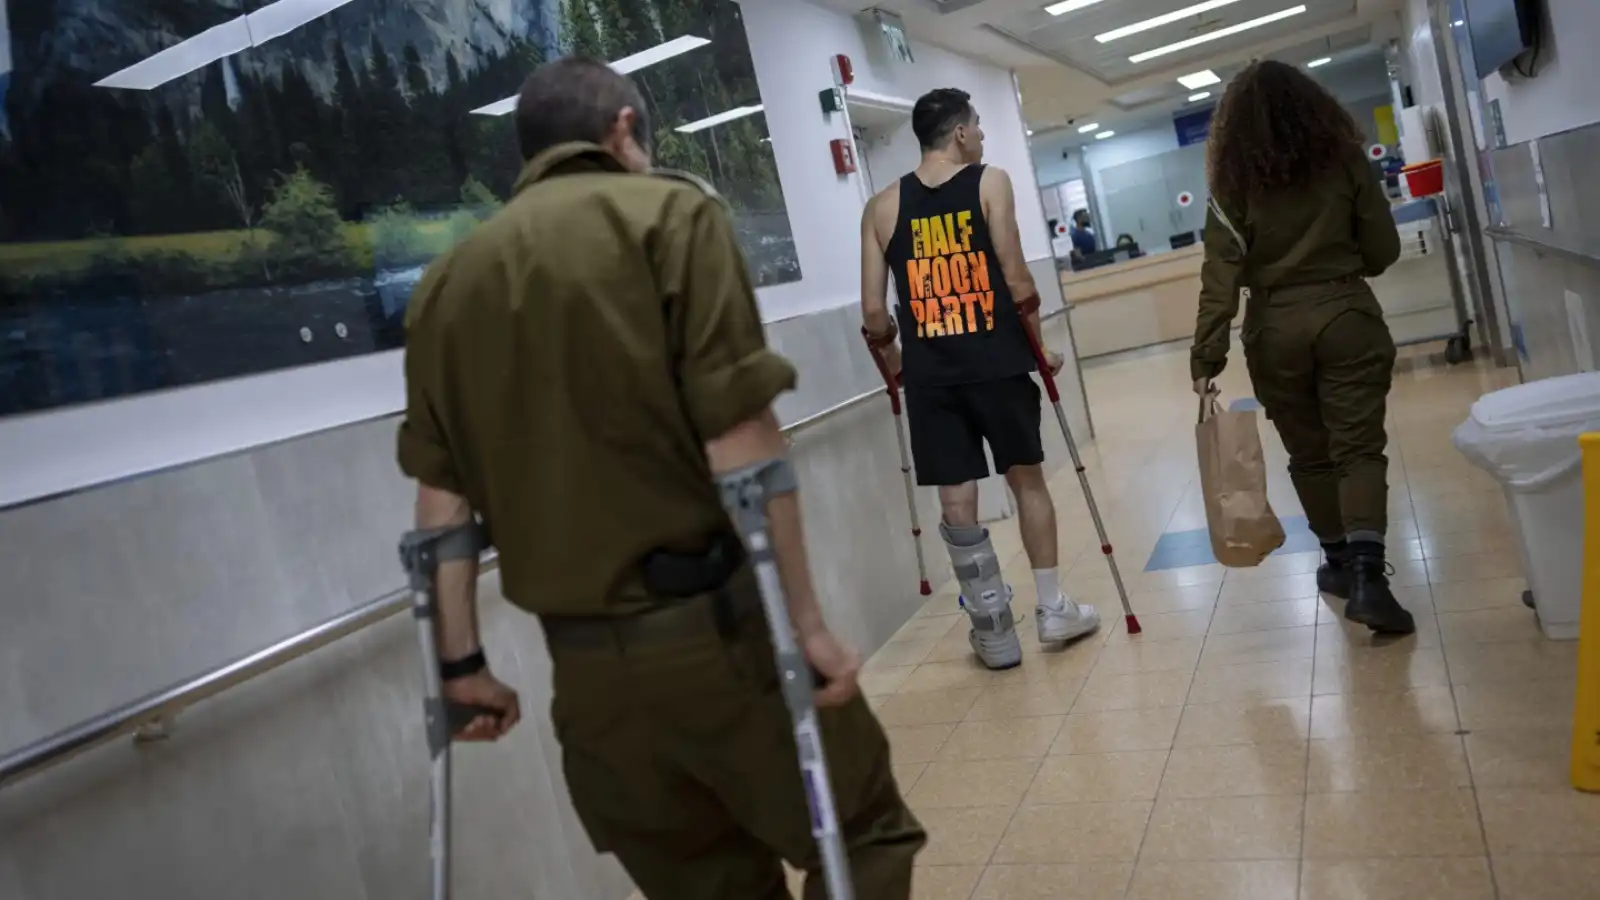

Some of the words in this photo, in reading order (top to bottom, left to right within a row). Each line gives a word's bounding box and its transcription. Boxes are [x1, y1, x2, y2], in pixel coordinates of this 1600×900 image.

[911, 210, 972, 258] HALF
[906, 250, 990, 300] MOON
[910, 291, 994, 337] PARTY
